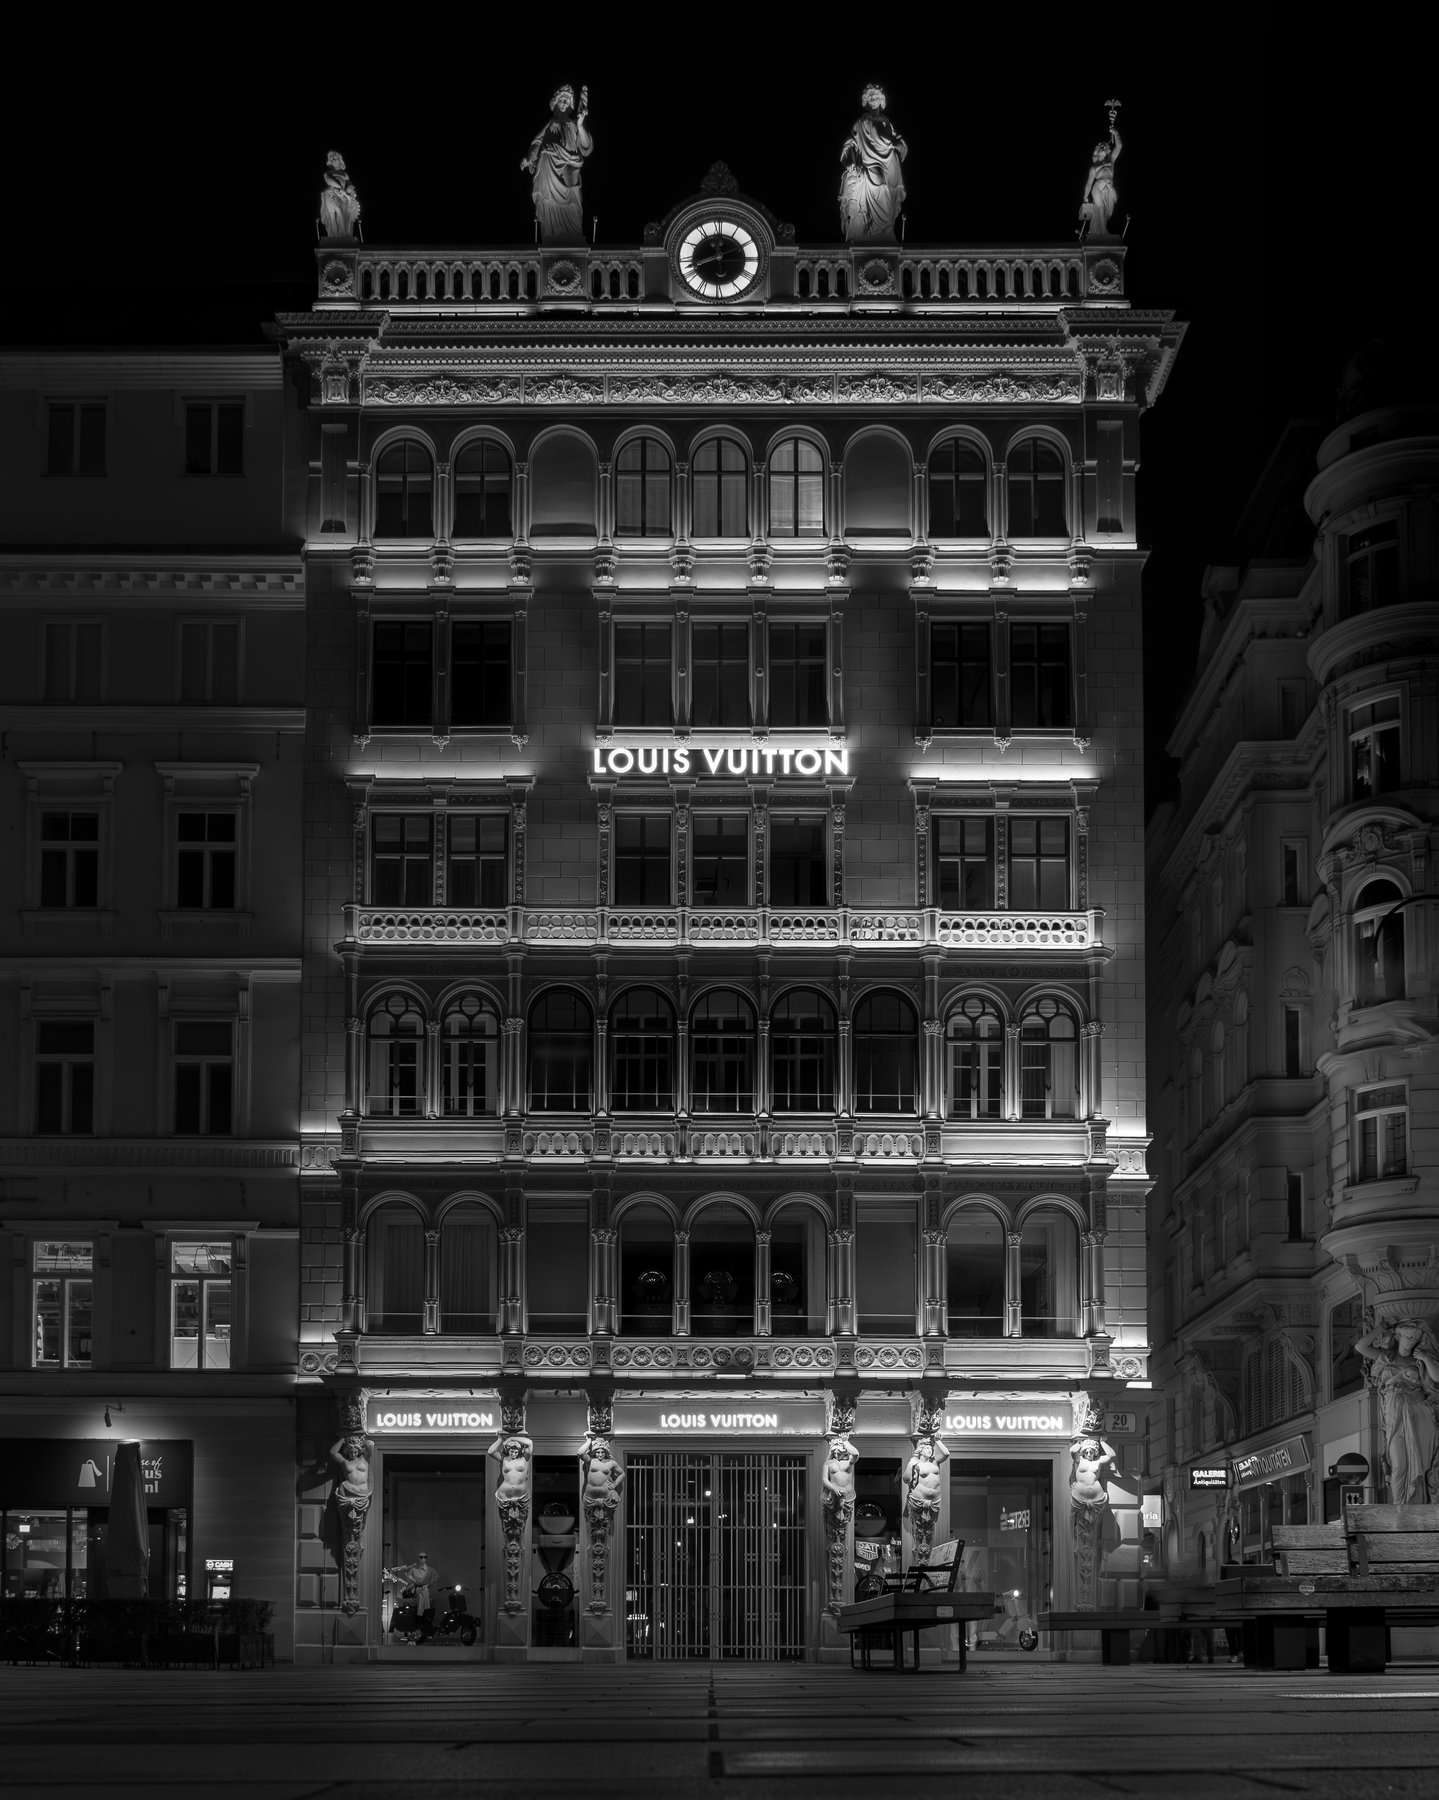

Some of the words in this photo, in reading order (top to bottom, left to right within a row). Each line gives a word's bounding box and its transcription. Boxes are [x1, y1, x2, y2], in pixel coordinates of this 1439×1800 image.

[593, 747, 690, 774] LOUIS
[703, 747, 849, 775] VUITTON
[376, 1412, 422, 1428] LOUIS
[425, 1412, 493, 1428] VUITTON
[660, 1413, 706, 1429] LOUIS
[710, 1413, 778, 1429] VUITTON
[945, 1414, 991, 1430] LOUIS
[995, 1414, 1063, 1431] VUITTON
[1112, 1414, 1127, 1426] 20
[1192, 1470, 1227, 1478] GALERIE
